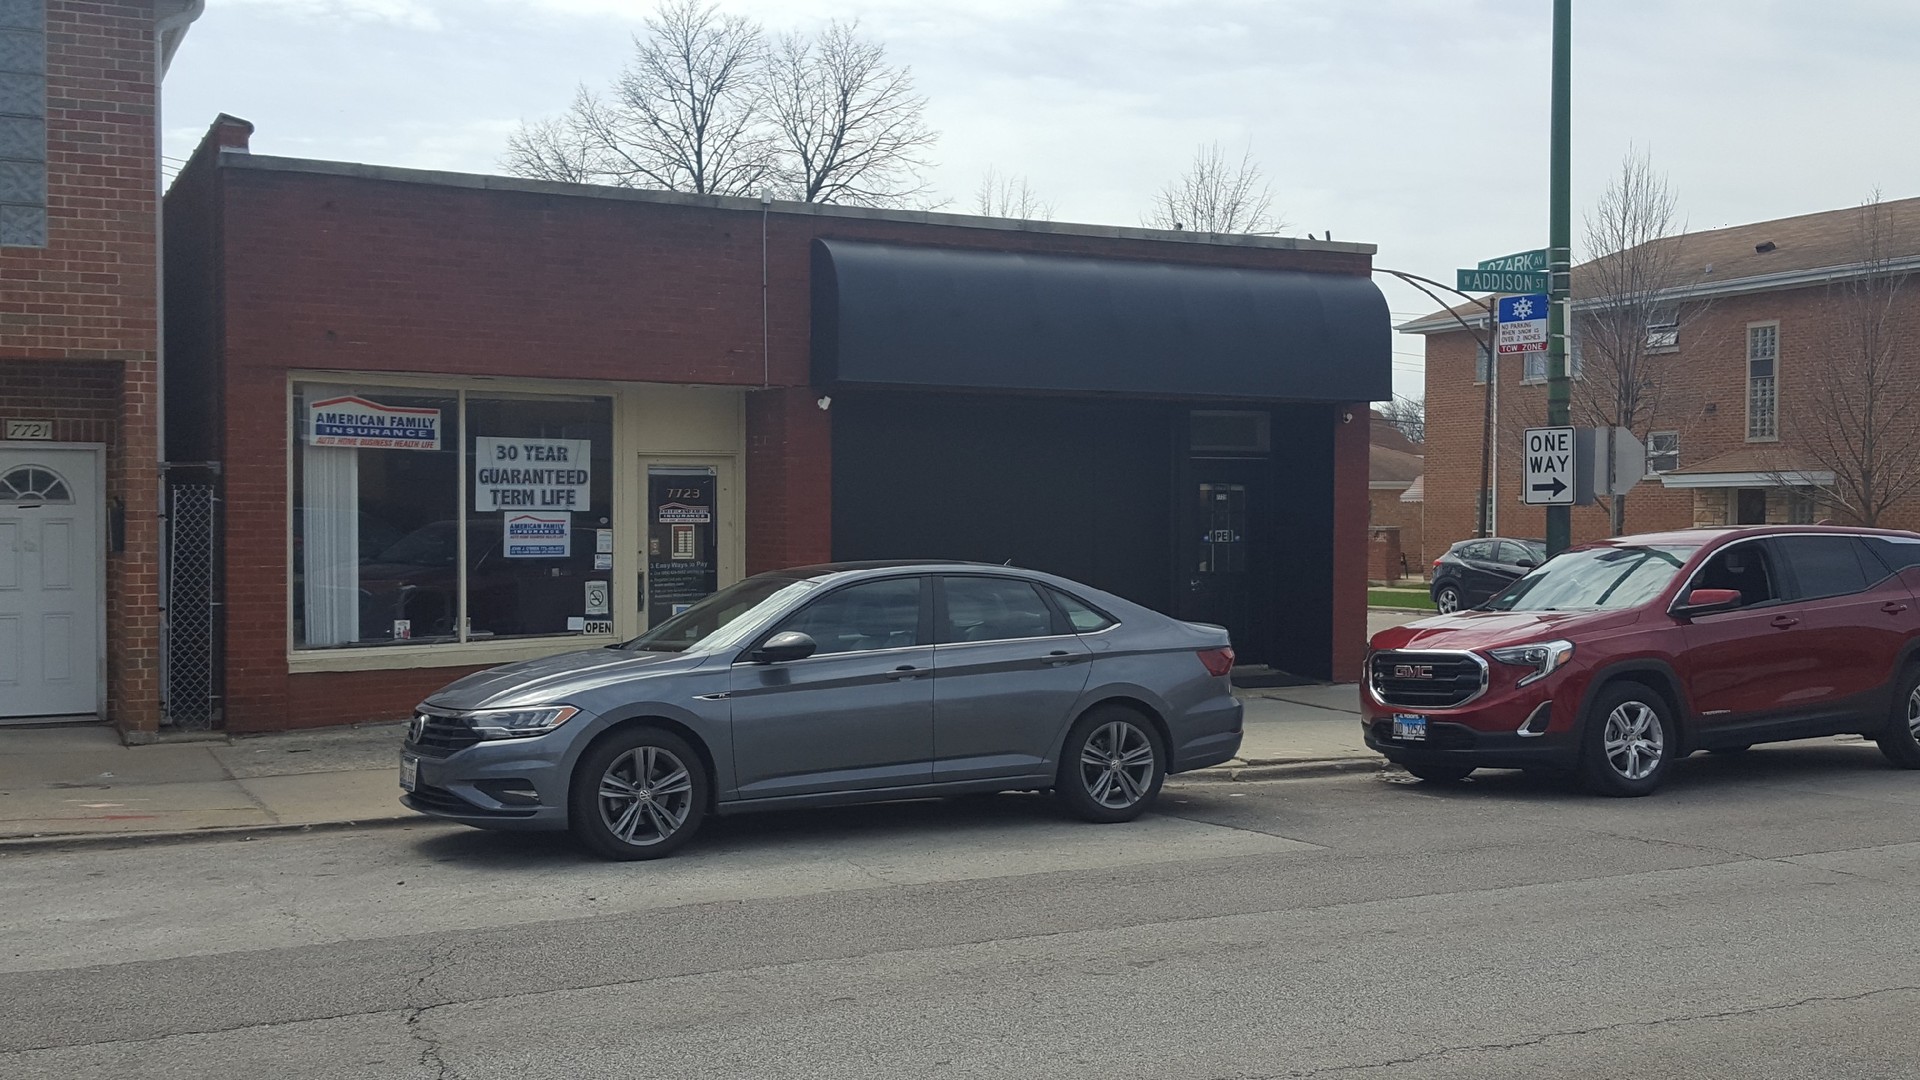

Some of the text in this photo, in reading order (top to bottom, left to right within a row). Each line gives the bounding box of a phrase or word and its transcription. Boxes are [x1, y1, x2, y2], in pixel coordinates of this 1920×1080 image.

[1487, 254, 1544, 271] OZARK AV
[1464, 273, 1545, 291] W ADDISON ST
[1522, 343, 1543, 351] ZONE
[316, 412, 435, 429] AMERICAN FAMILY
[10, 424, 48, 437] 7721
[325, 427, 428, 437] INSURANCE
[360, 439, 392, 447] BUSINESS
[1530, 433, 1569, 453] ONE
[496, 445, 569, 462] 30 YEAR
[1529, 455, 1569, 473] WAY
[479, 468, 588, 485] GUARANTEED
[489, 489, 576, 506] TERM LIFE
[667, 488, 700, 498] 7723
[585, 622, 611, 633] OPEN
[1394, 665, 1432, 678] GMC
